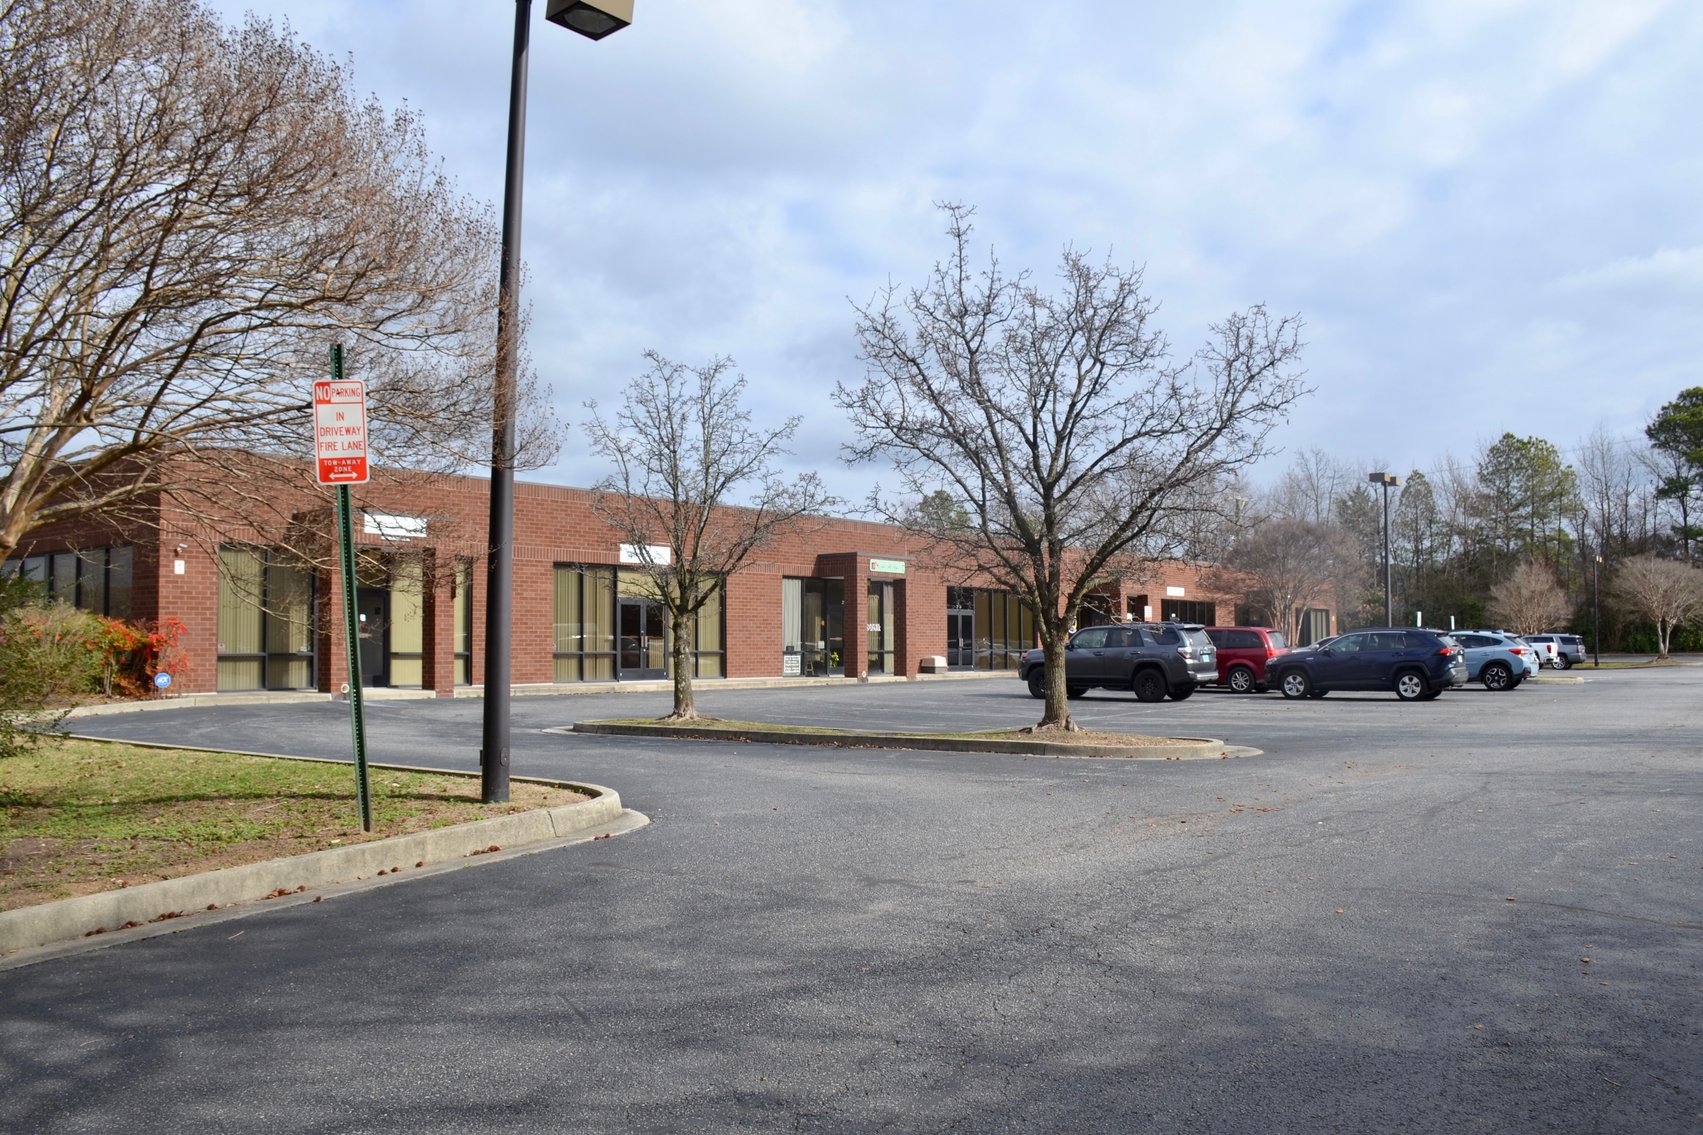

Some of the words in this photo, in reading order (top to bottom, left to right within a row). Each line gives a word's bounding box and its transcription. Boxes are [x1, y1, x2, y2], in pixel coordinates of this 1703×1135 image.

[315, 385, 330, 401] NO
[331, 387, 361, 398] PARKING
[336, 412, 344, 421] IN
[320, 427, 361, 437] DRIVEWAY
[320, 441, 338, 451] FIRE
[342, 441, 363, 450] LANE
